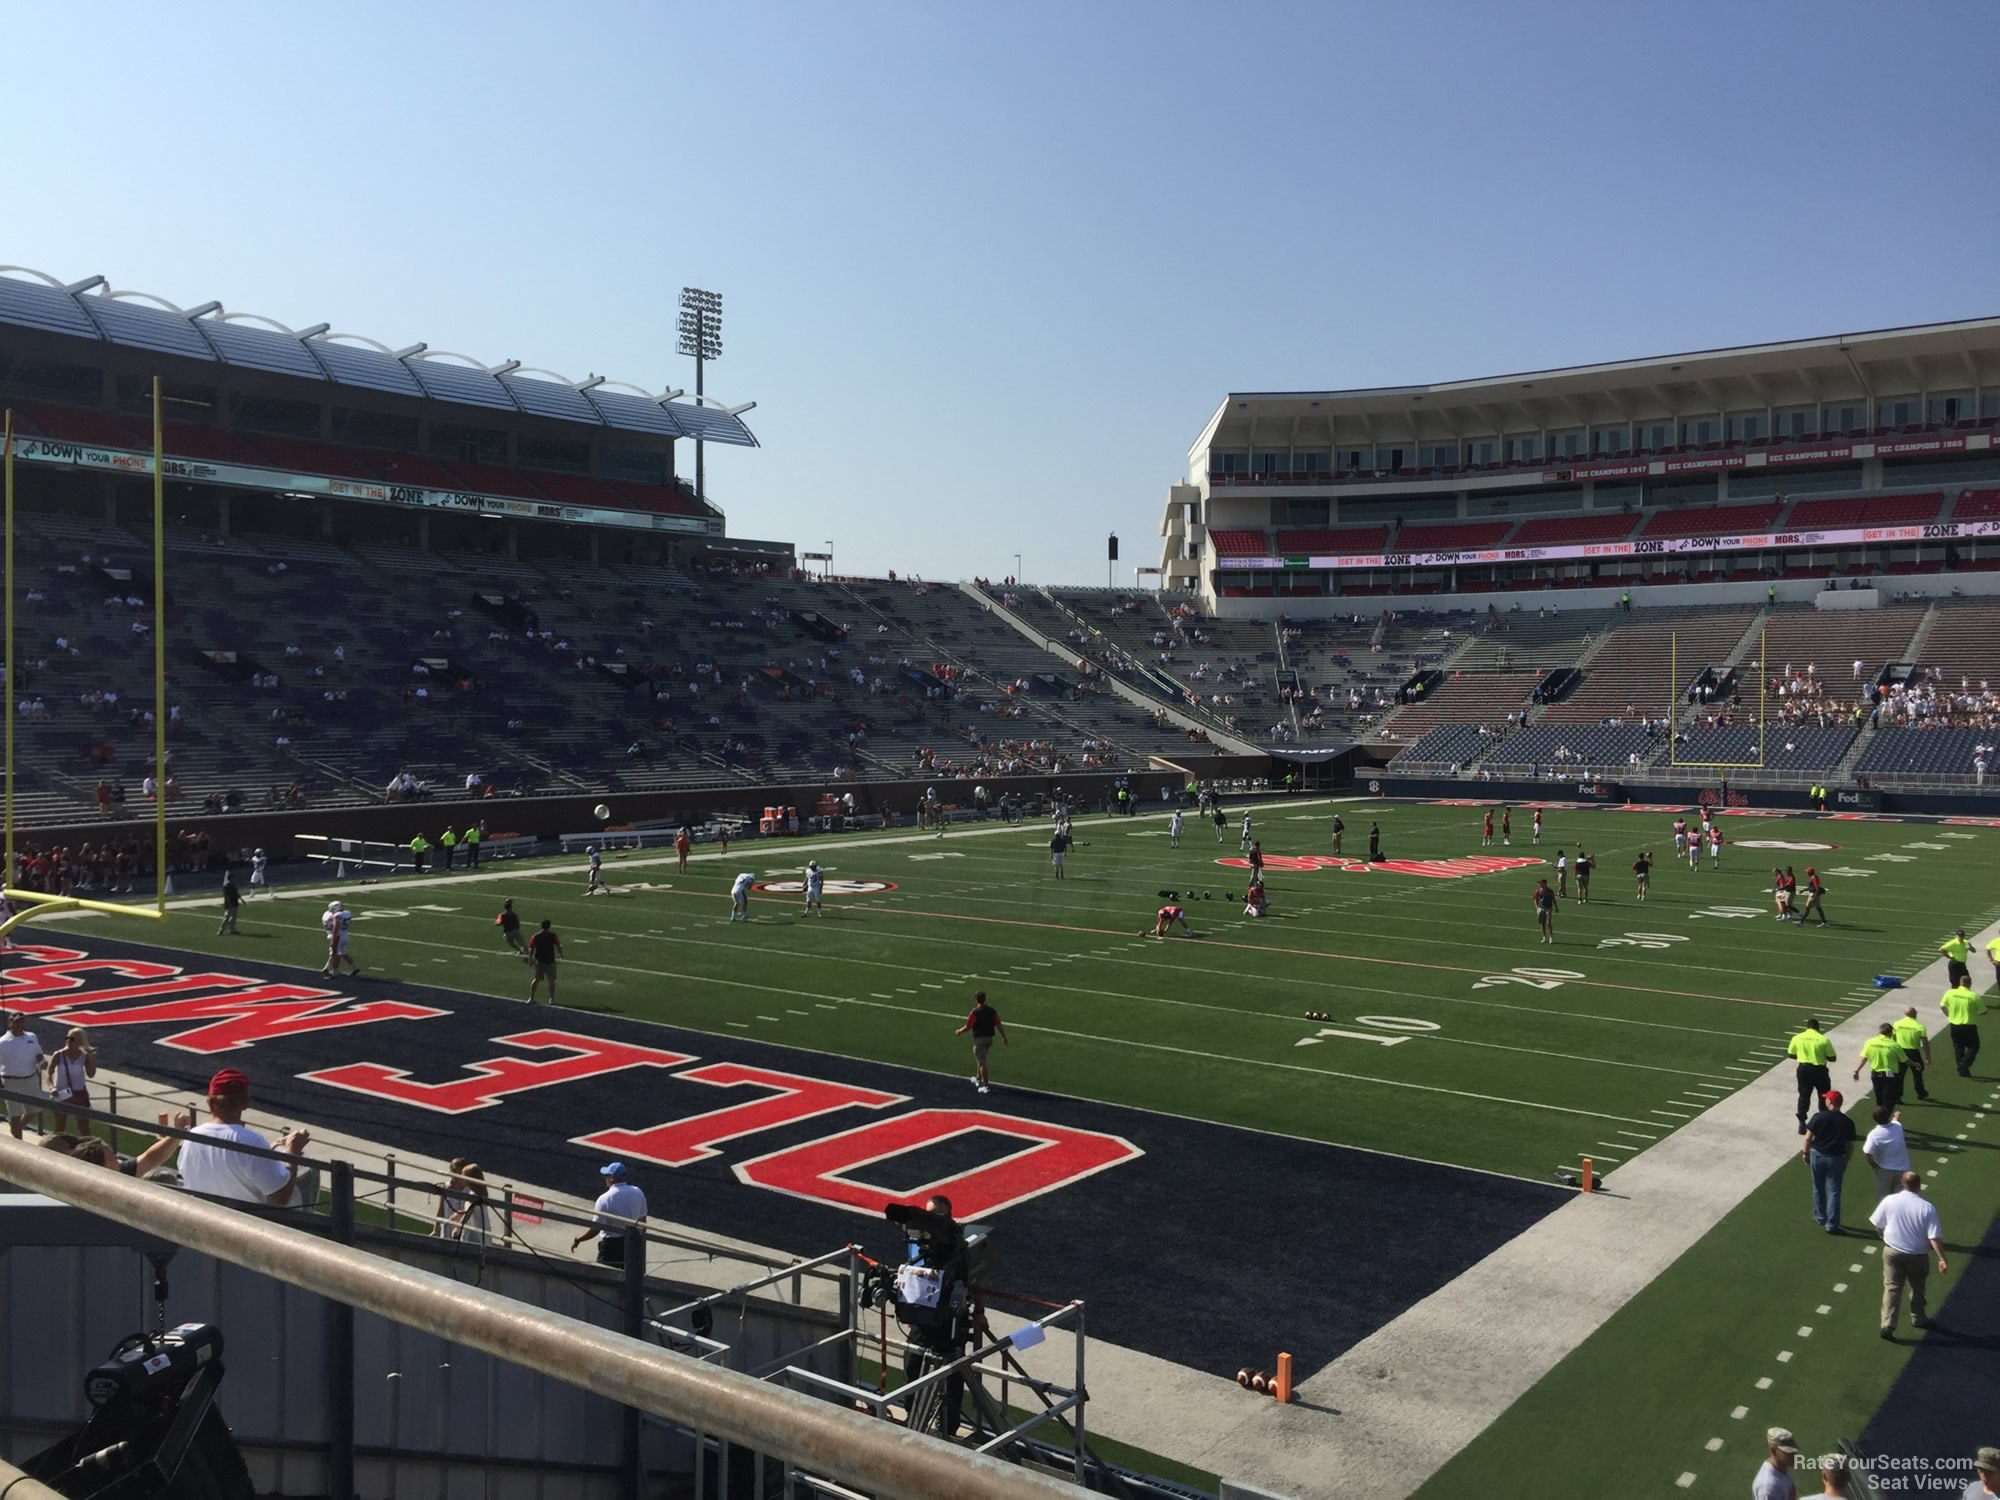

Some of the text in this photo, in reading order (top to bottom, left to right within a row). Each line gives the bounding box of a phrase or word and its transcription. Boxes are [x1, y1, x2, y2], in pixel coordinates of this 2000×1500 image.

[1895, 442, 1940, 452] CHAMPIONS
[23, 441, 38, 458] PUT
[41, 443, 82, 464] DOWN
[86, 452, 110, 463] YOUR
[112, 455, 146, 469] PHONE
[161, 461, 186, 475] DRS
[1769, 454, 1783, 462] SEC
[1785, 451, 1828, 461] CHAMPIONS
[1683, 459, 1723, 469] CHAMPIONS
[1590, 468, 1628, 477] CHAMPIONS
[332, 483, 424, 503] GET IN THE ZONE
[454, 495, 484, 511] DOWN
[486, 501, 505, 510] YOUR
[507, 502, 532, 513] PHONE
[1866, 524, 1958, 539] GET IN THE ZONE
[1977, 523, 1989, 534] PUT
[1586, 541, 1664, 554] GET IN THE ZONE
[1679, 540, 1690, 550] PUT
[1692, 537, 1720, 550] DOWN
[1742, 536, 1768, 545] PHONE
[1340, 558, 1354, 566] GET
[1366, 556, 1379, 564] THE
[1384, 555, 1411, 565] ZONE
[1435, 552, 1460, 564] DOWN
[1478, 551, 1499, 559] PHONE
[1579, 784, 1608, 794] FedEx
[1838, 792, 1872, 803] FedEx
[1600, 932, 1690, 949] 30
[1481, 967, 1586, 990] 20
[1315, 1015, 1441, 1047] 10
[295, 1028, 1145, 1225] OLE
